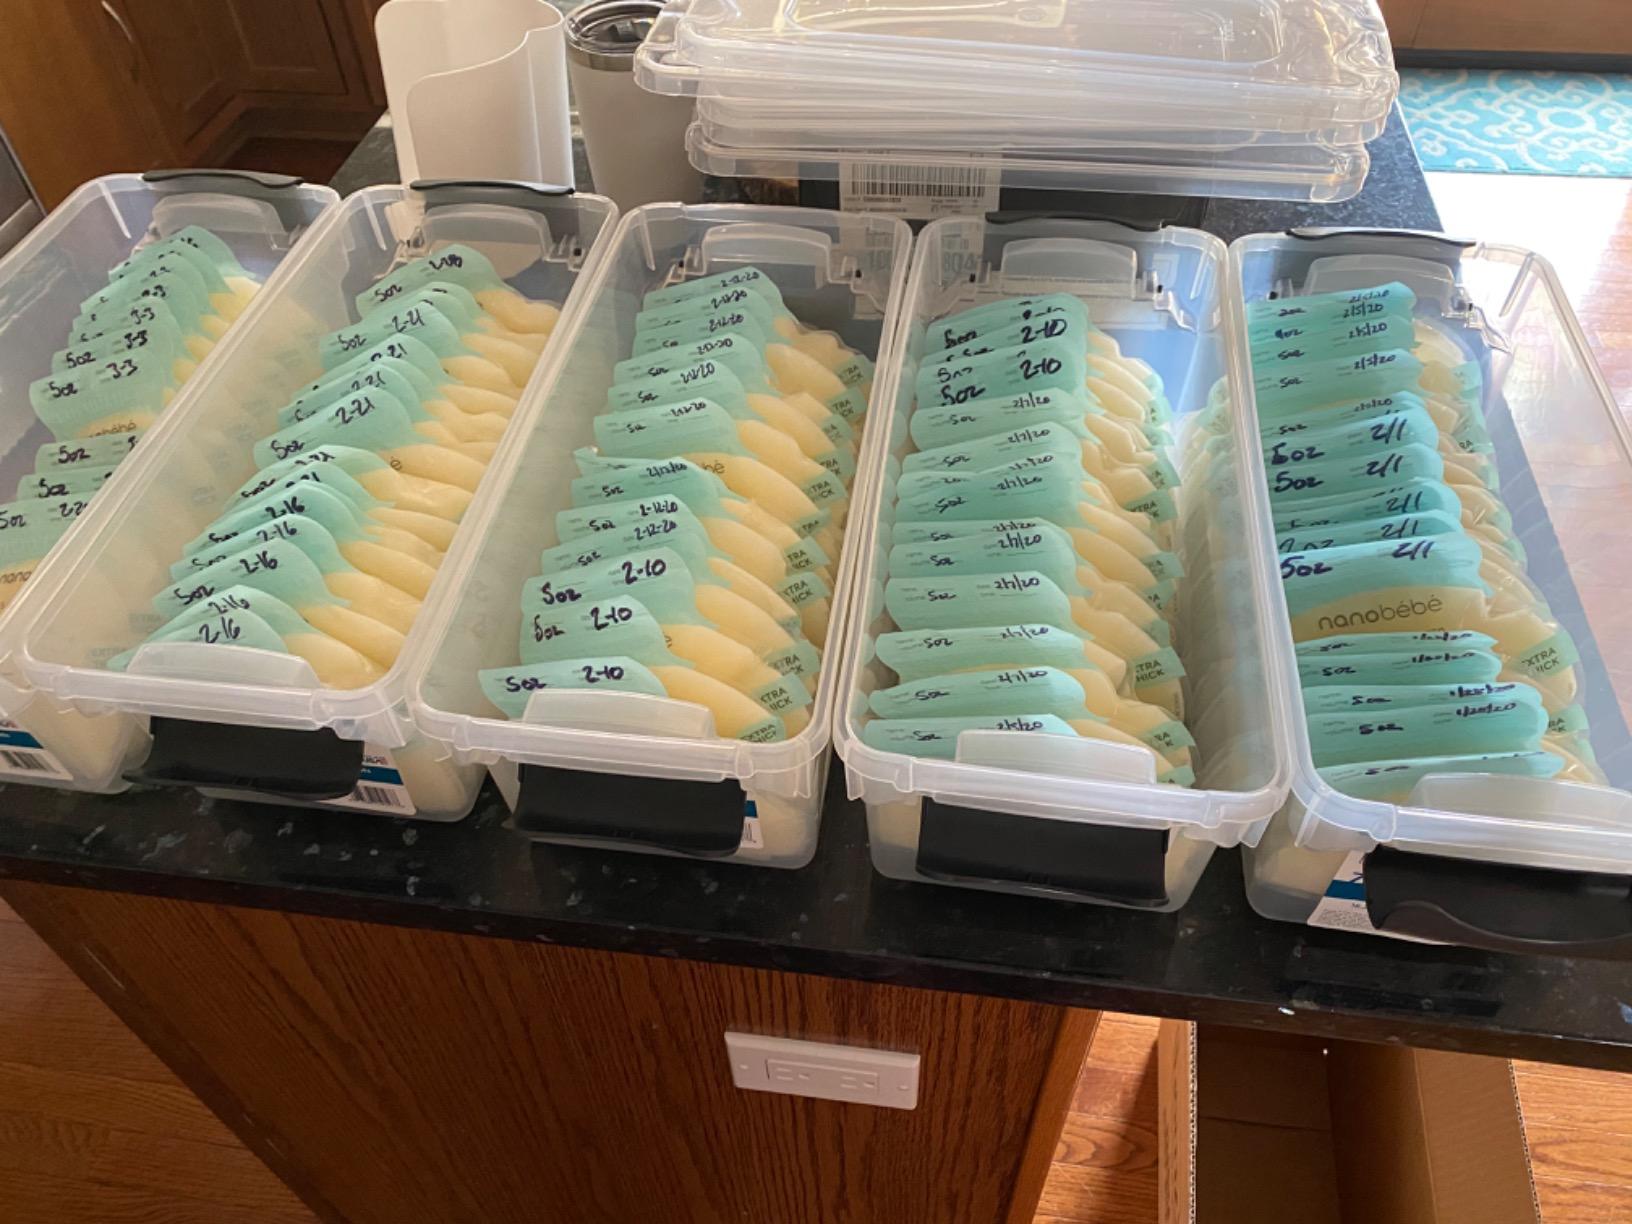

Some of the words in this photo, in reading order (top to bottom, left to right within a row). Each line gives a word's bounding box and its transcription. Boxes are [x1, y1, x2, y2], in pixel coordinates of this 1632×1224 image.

[374, 284, 402, 302] 5oz
[391, 308, 426, 333] 2-21
[1020, 318, 1068, 344] 2-10
[66, 351, 97, 369] 5oz
[105, 359, 138, 380] 3-3
[1019, 357, 1062, 380] 2-10
[48, 381, 79, 399] 5oz
[940, 385, 986, 408] 5oz
[336, 396, 376, 425] 2-21
[951, 414, 976, 425] 5oz
[1370, 417, 1408, 445] 2/1
[58, 445, 91, 464] 5oz
[271, 439, 306, 460] 5oz
[1366, 453, 1403, 478] 2/1
[38, 478, 70, 498] 5oz
[1273, 471, 1325, 493] 5oz
[1386, 491, 1423, 514] 2/1
[256, 521, 298, 542] 2-16
[589, 520, 616, 532] 5oz
[1381, 518, 1418, 539] 2/1
[998, 532, 1042, 550] 2/7/20
[1392, 540, 1436, 561] 2/1
[240, 551, 279, 574] 2-16
[622, 559, 667, 585] 2-10
[1280, 555, 1333, 580] 5oz
[994, 574, 1041, 591] 2/7/20
[174, 585, 215, 605] 5oz
[540, 582, 582, 605] 5oz
[591, 607, 633, 631] 2-10
[1317, 595, 1443, 631] nanobébé
[199, 617, 240, 644] 2-16
[533, 614, 565, 643] 5oz
[924, 637, 954, 649] 5oz
[505, 675, 548, 693] 5oz
[582, 665, 625, 684] 2-10
